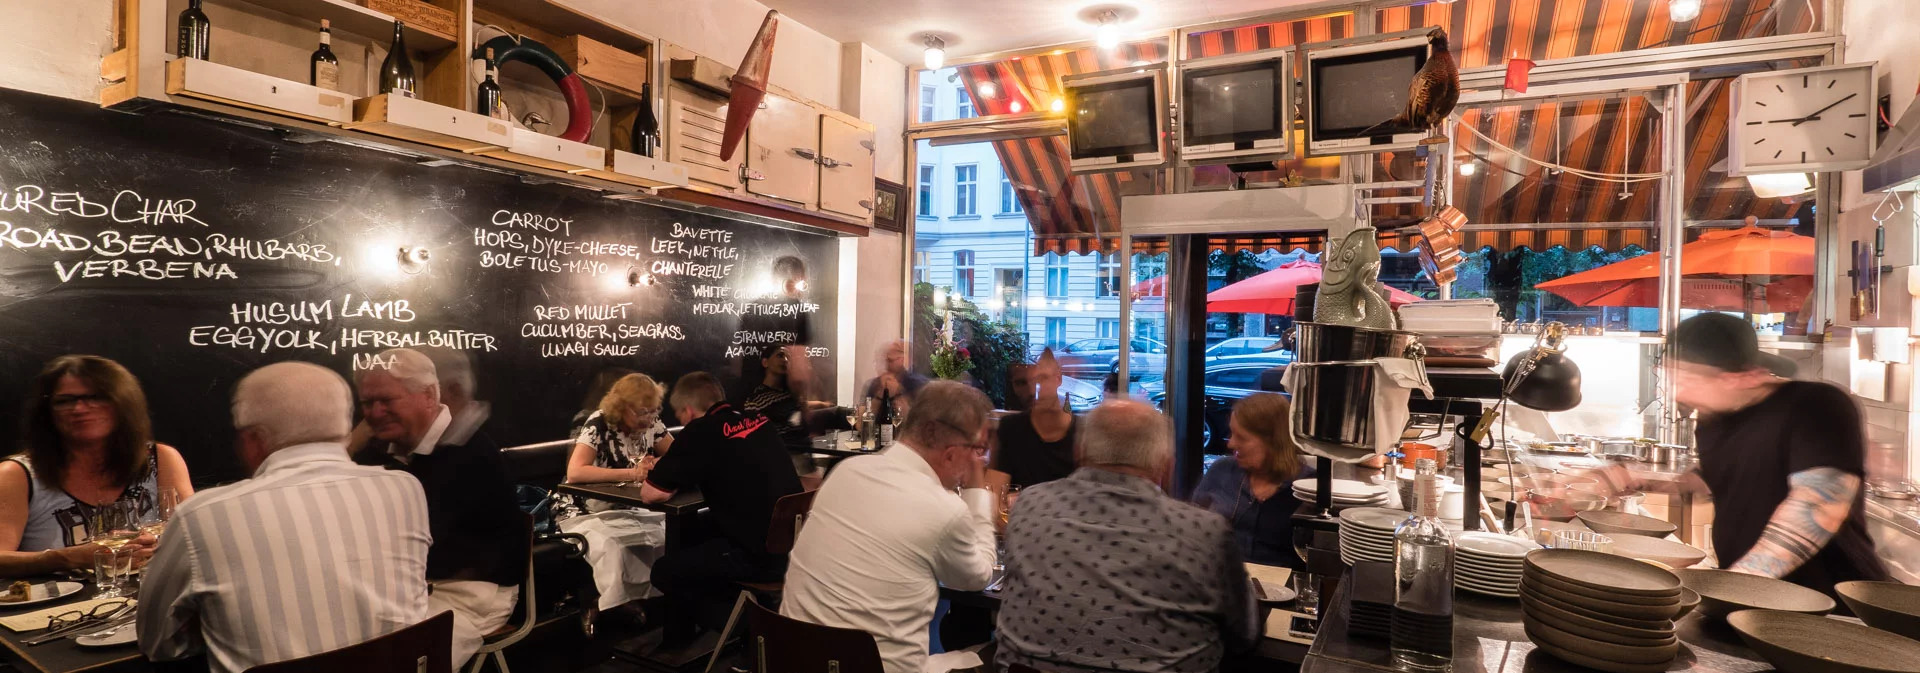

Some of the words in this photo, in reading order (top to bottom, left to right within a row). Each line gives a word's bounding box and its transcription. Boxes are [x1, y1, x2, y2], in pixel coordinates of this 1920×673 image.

[0, 185, 108, 218] URED
[111, 190, 209, 227] CHAR
[492, 209, 573, 237] CARROT
[670, 222, 733, 243] BAVETTE
[206, 234, 342, 266] RHUBARB,
[474, 228, 528, 253] HOPS,
[532, 235, 641, 260] DYKE-CHEESE,
[651, 237, 692, 259] LEEK,
[693, 245, 739, 260] NETTLE,
[54, 259, 238, 282] VERBENA
[479, 250, 608, 277] BOLETUS-MAYO
[652, 260, 734, 279] CHANTERELLE
[692, 284, 730, 299] WHITE
[230, 300, 332, 324] HUSUM
[341, 294, 416, 322] LAMB
[534, 305, 569, 321] RED
[575, 302, 633, 320] MULLET
[693, 303, 740, 317] MEDLAR,
[740, 302, 782, 317] LETTUCE,
[189, 325, 336, 355] EGGYOLK,
[521, 323, 616, 342] CUCUMBER,
[618, 323, 686, 341] SEAGRASS,
[732, 330, 798, 345] STRAWBERRY
[541, 342, 589, 357] UNAGI
[593, 344, 640, 356] SAUCE
[725, 346, 762, 359] ACACIA,
[804, 346, 830, 358] SEED
